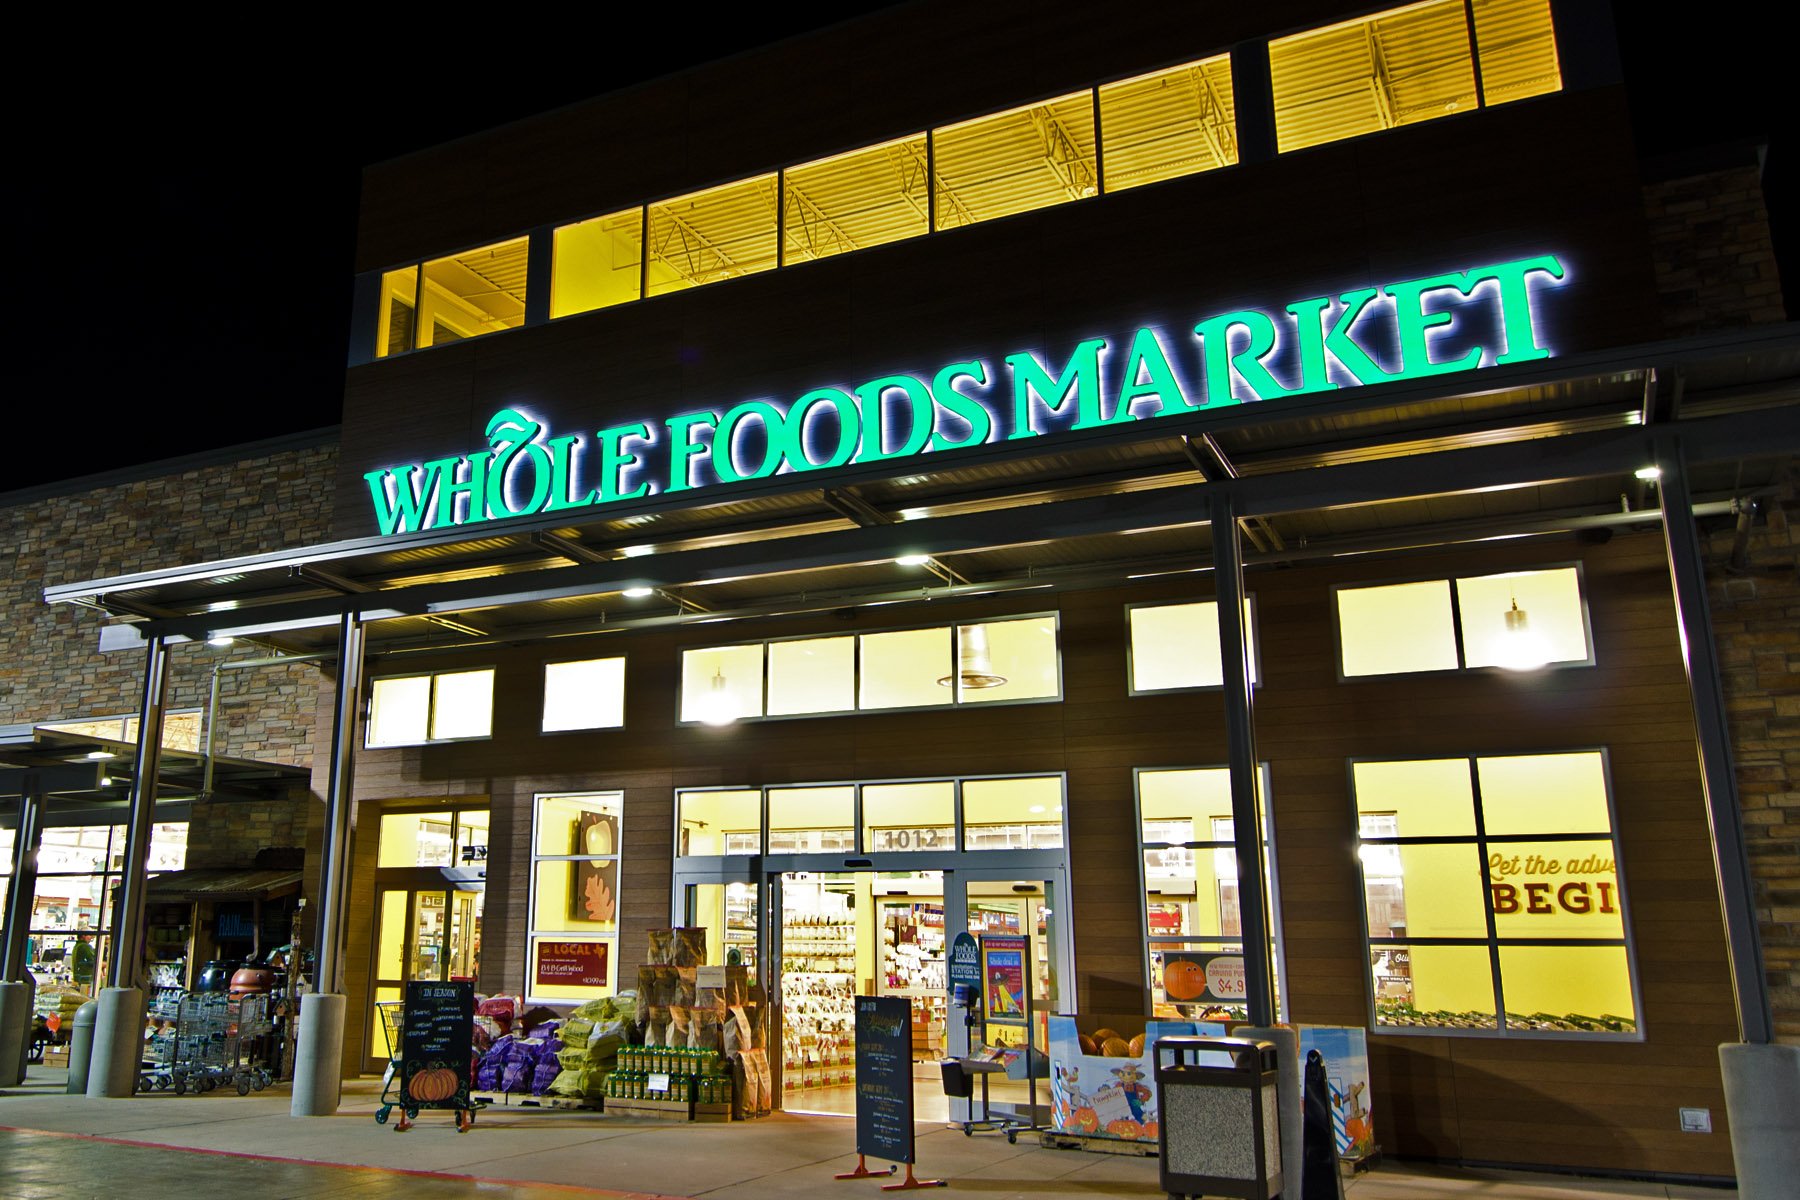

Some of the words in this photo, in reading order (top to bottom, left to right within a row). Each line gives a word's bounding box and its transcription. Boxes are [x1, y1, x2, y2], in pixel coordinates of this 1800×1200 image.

[363, 408, 651, 536] WHOLE
[663, 361, 992, 494] FOODS
[1005, 254, 1565, 441] MARKET
[885, 829, 938, 849] 1012
[1479, 853, 1522, 881] Let
[1525, 854, 1562, 875] the
[219, 913, 240, 936] RAIN
[554, 944, 591, 956] LOCAL
[955, 943, 977, 953] WHOLE
[423, 988, 432, 997] IN
[433, 988, 456, 997] SEASON
